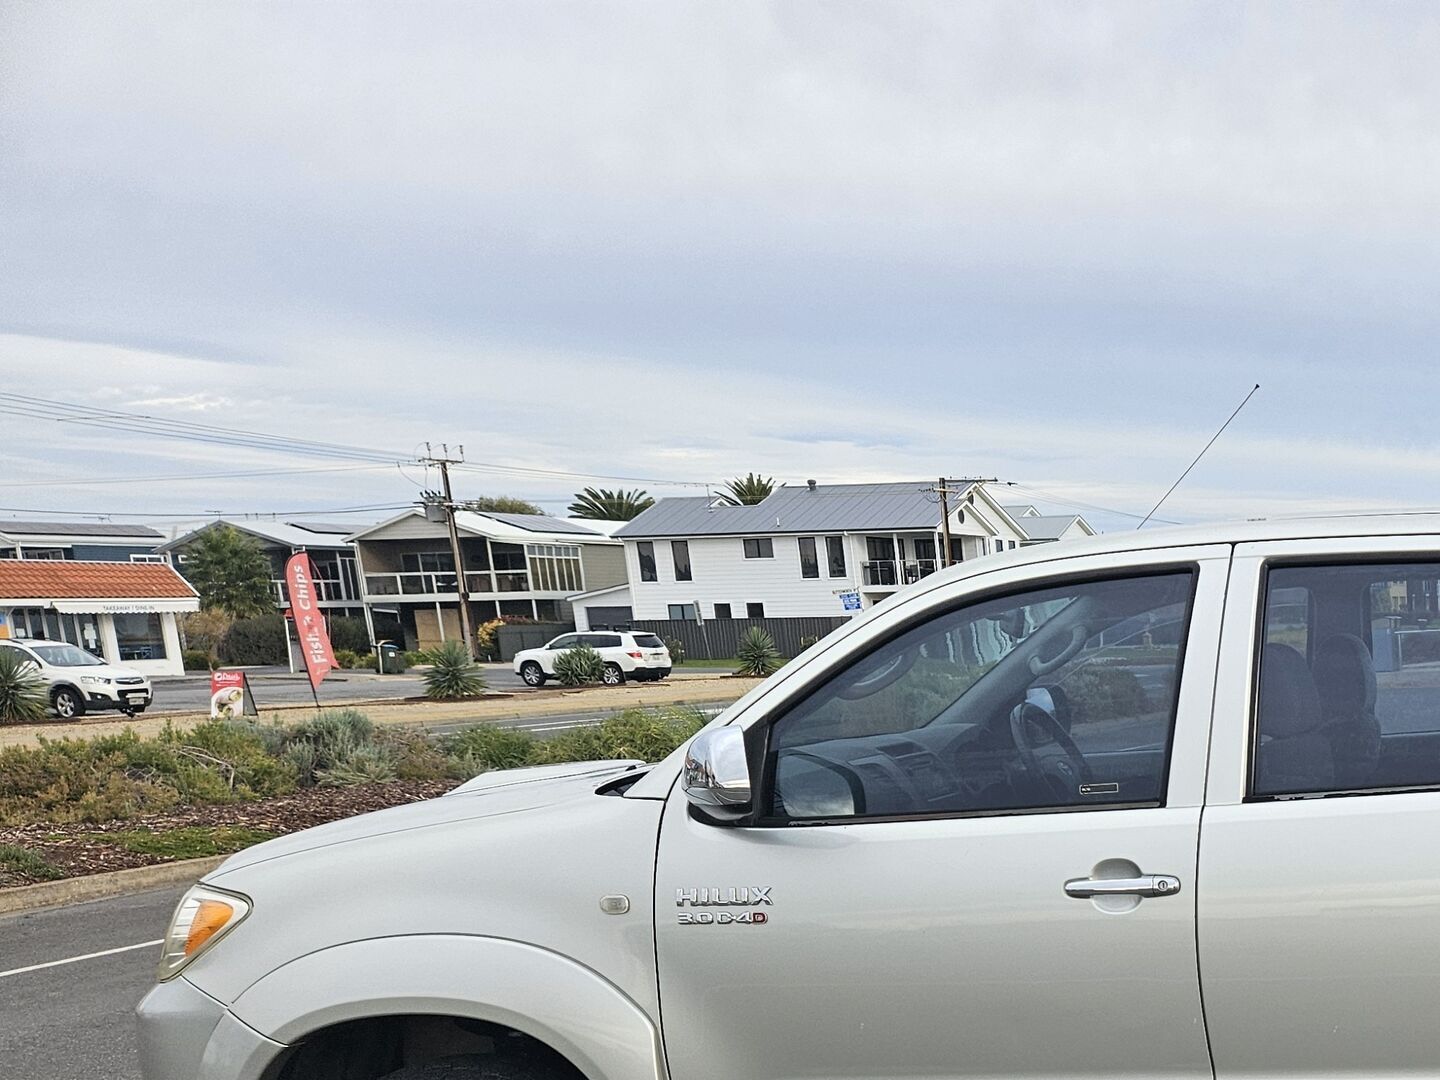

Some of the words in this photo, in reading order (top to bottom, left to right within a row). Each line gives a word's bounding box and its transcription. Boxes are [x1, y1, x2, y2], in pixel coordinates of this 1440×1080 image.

[294, 565, 311, 611] Chips
[306, 631, 328, 664] Fish
[676, 887, 774, 907] HILUX
[677, 911, 714, 925] 3.0
